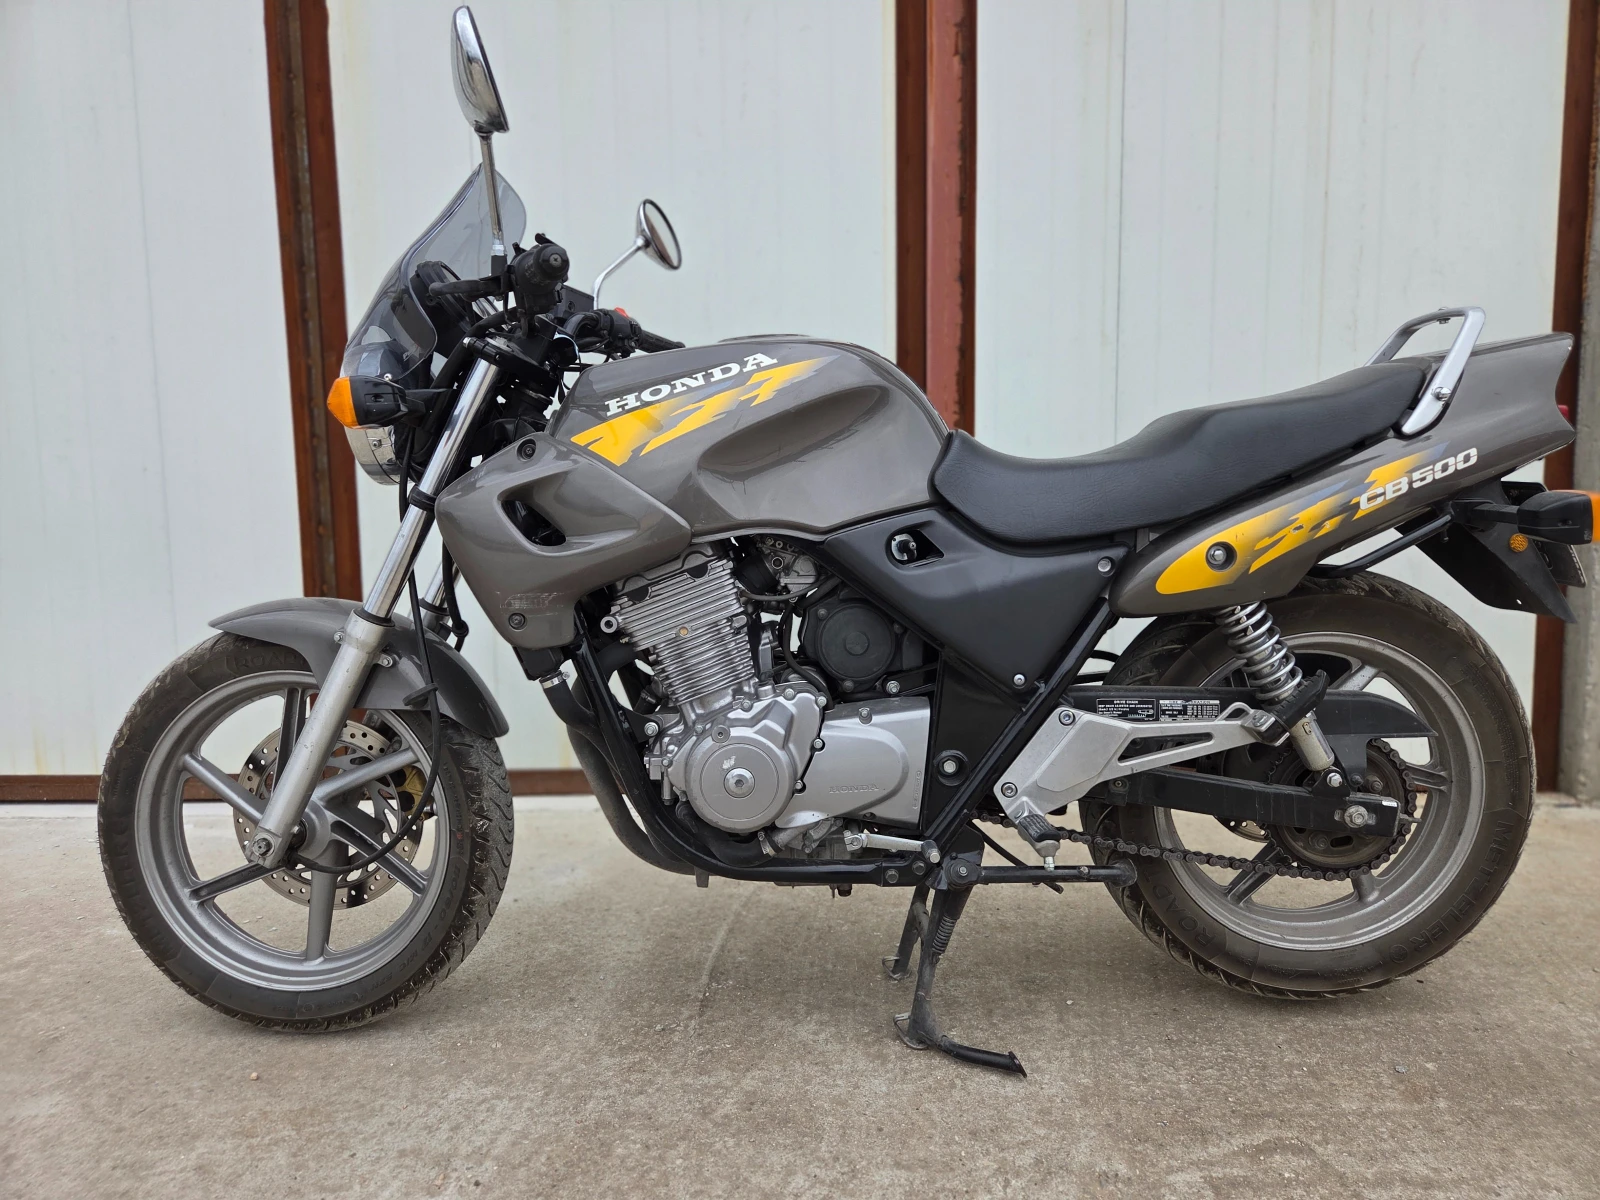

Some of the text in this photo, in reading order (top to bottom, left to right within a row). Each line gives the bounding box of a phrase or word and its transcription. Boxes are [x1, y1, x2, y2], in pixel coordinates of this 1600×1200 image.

[604, 352, 778, 417] HONDA
[234, 651, 306, 670] ROAD
[828, 783, 880, 794] HONDA
[1408, 820, 1515, 953] METZELER
